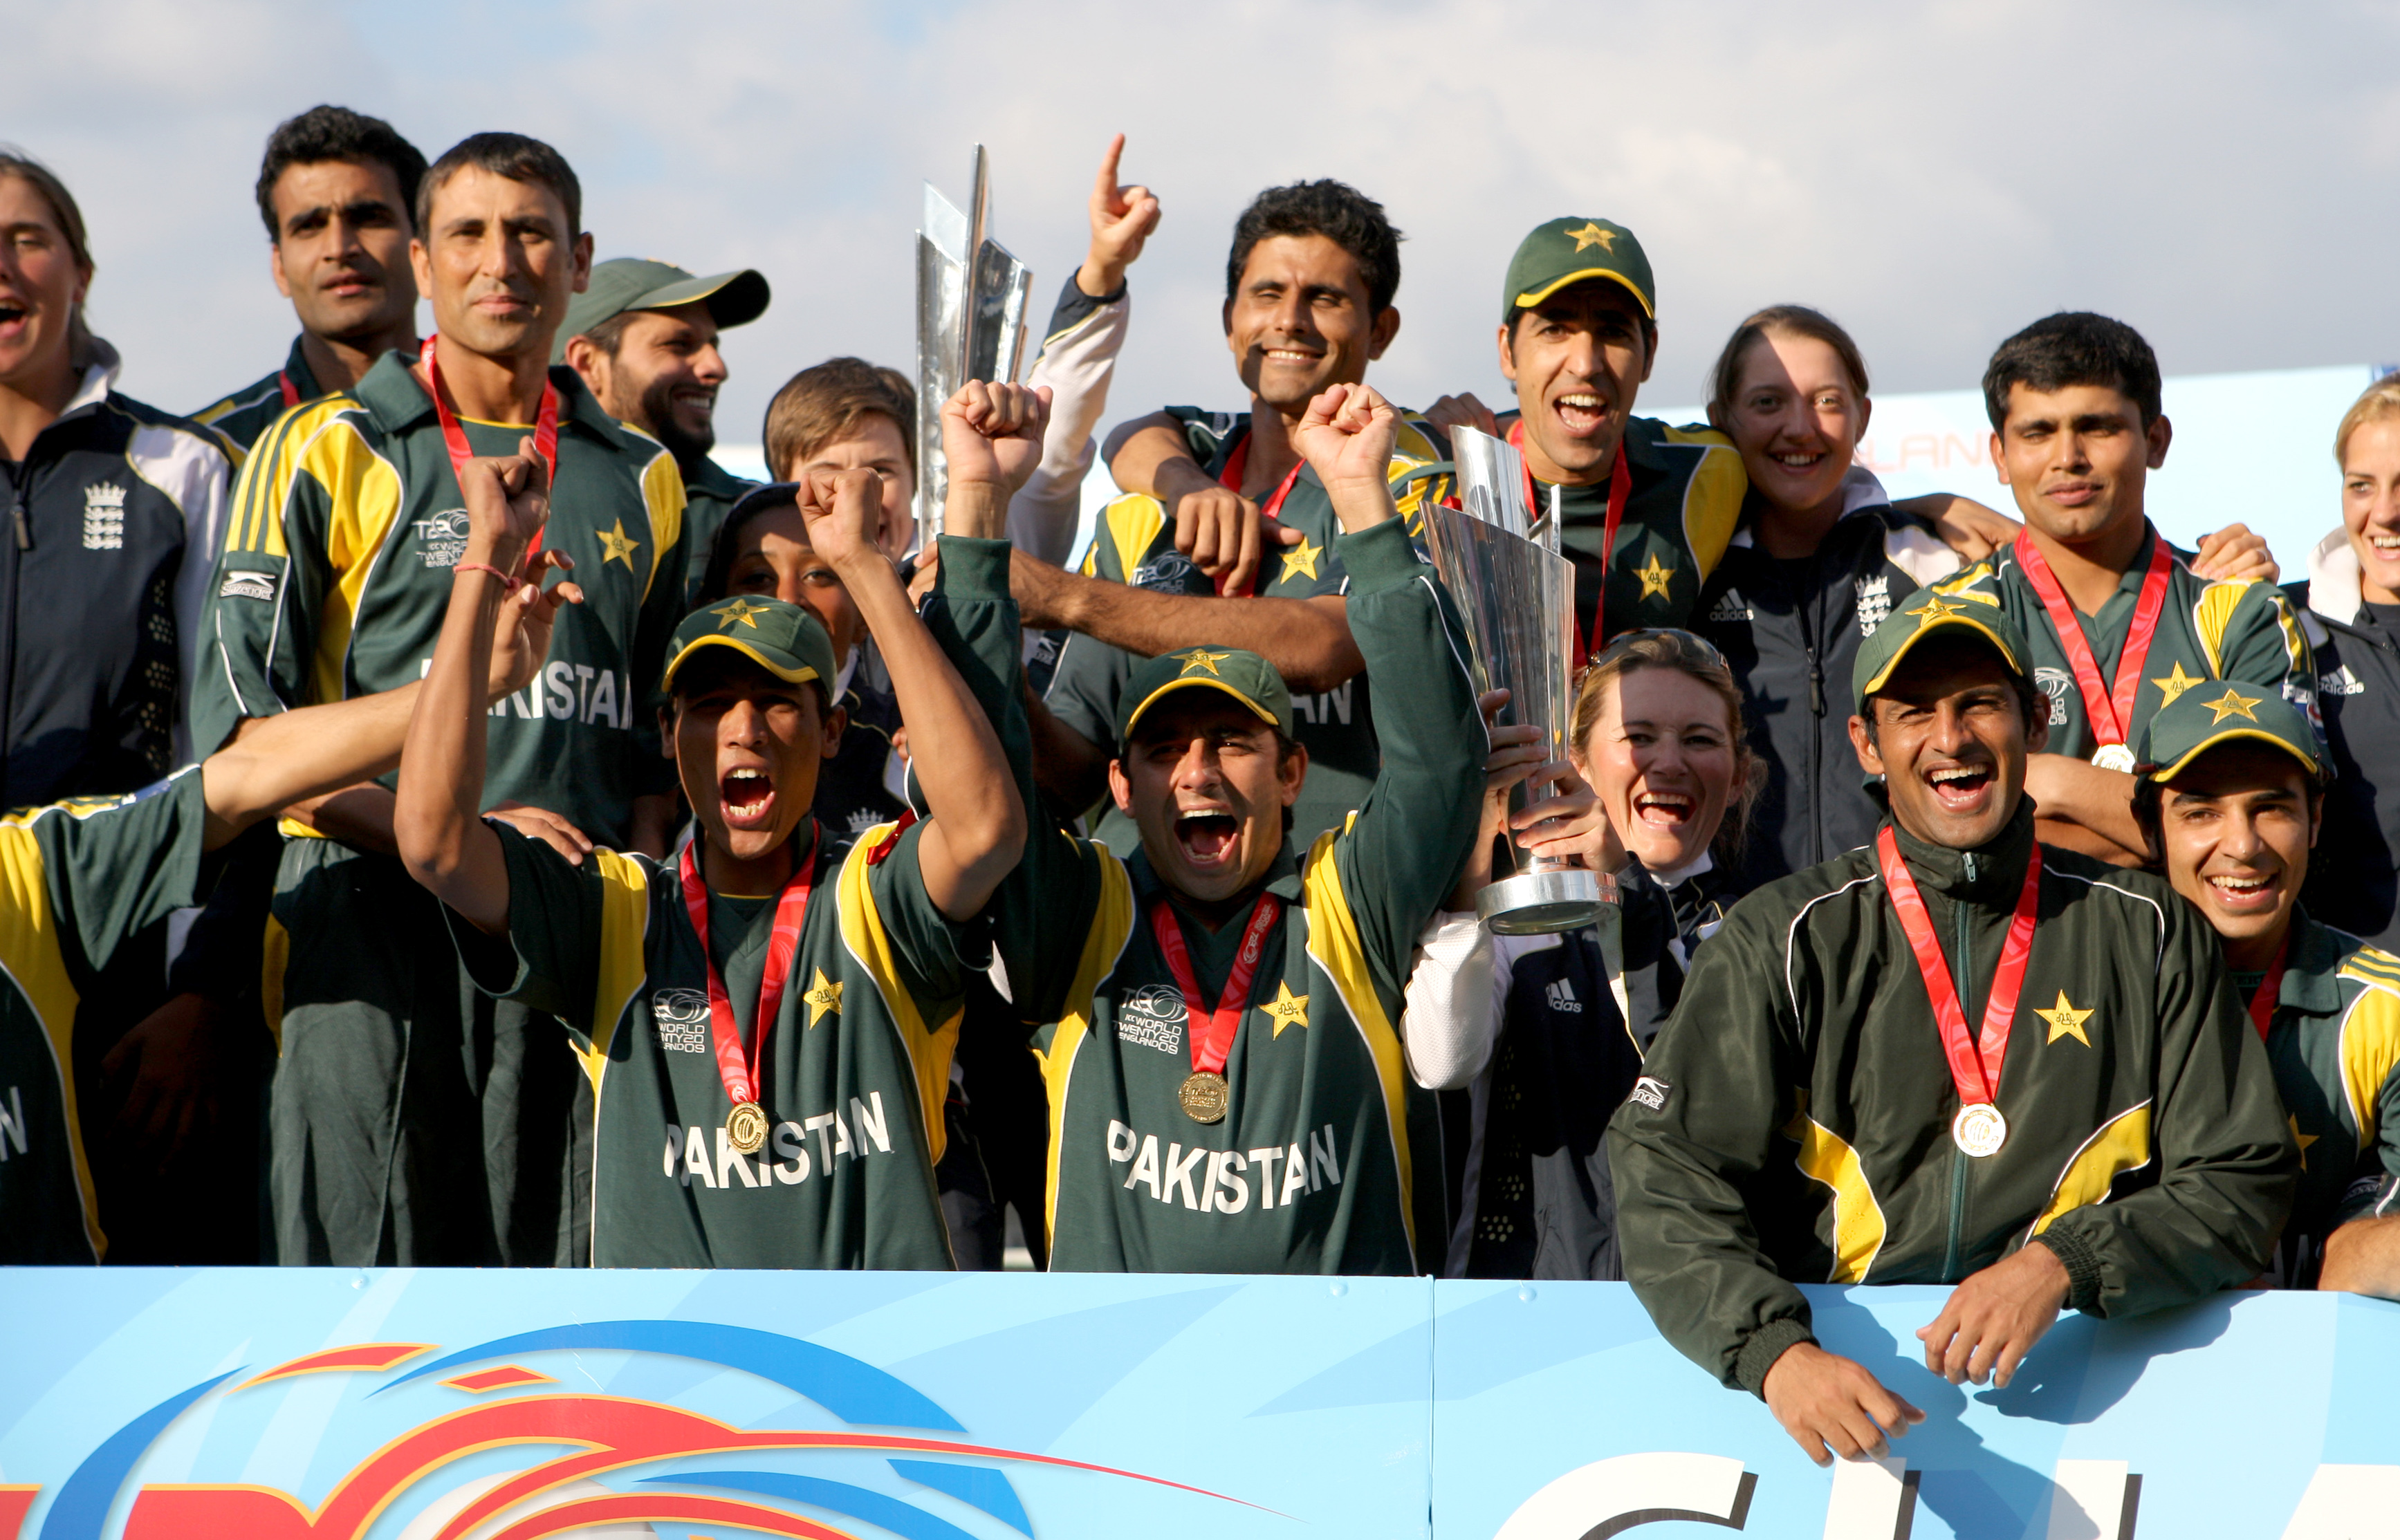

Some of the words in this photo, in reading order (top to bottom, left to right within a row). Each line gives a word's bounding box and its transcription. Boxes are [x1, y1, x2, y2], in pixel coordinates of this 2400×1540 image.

[1709, 609, 1754, 622] adidas
[658, 1022, 705, 1035] WORLD
[1112, 1019, 1180, 1046] TWENTY20
[1135, 1015, 1183, 1037] WORLD
[663, 1090, 894, 1189] PAKISTAN
[1106, 1118, 1342, 1215] PAKISTAN
